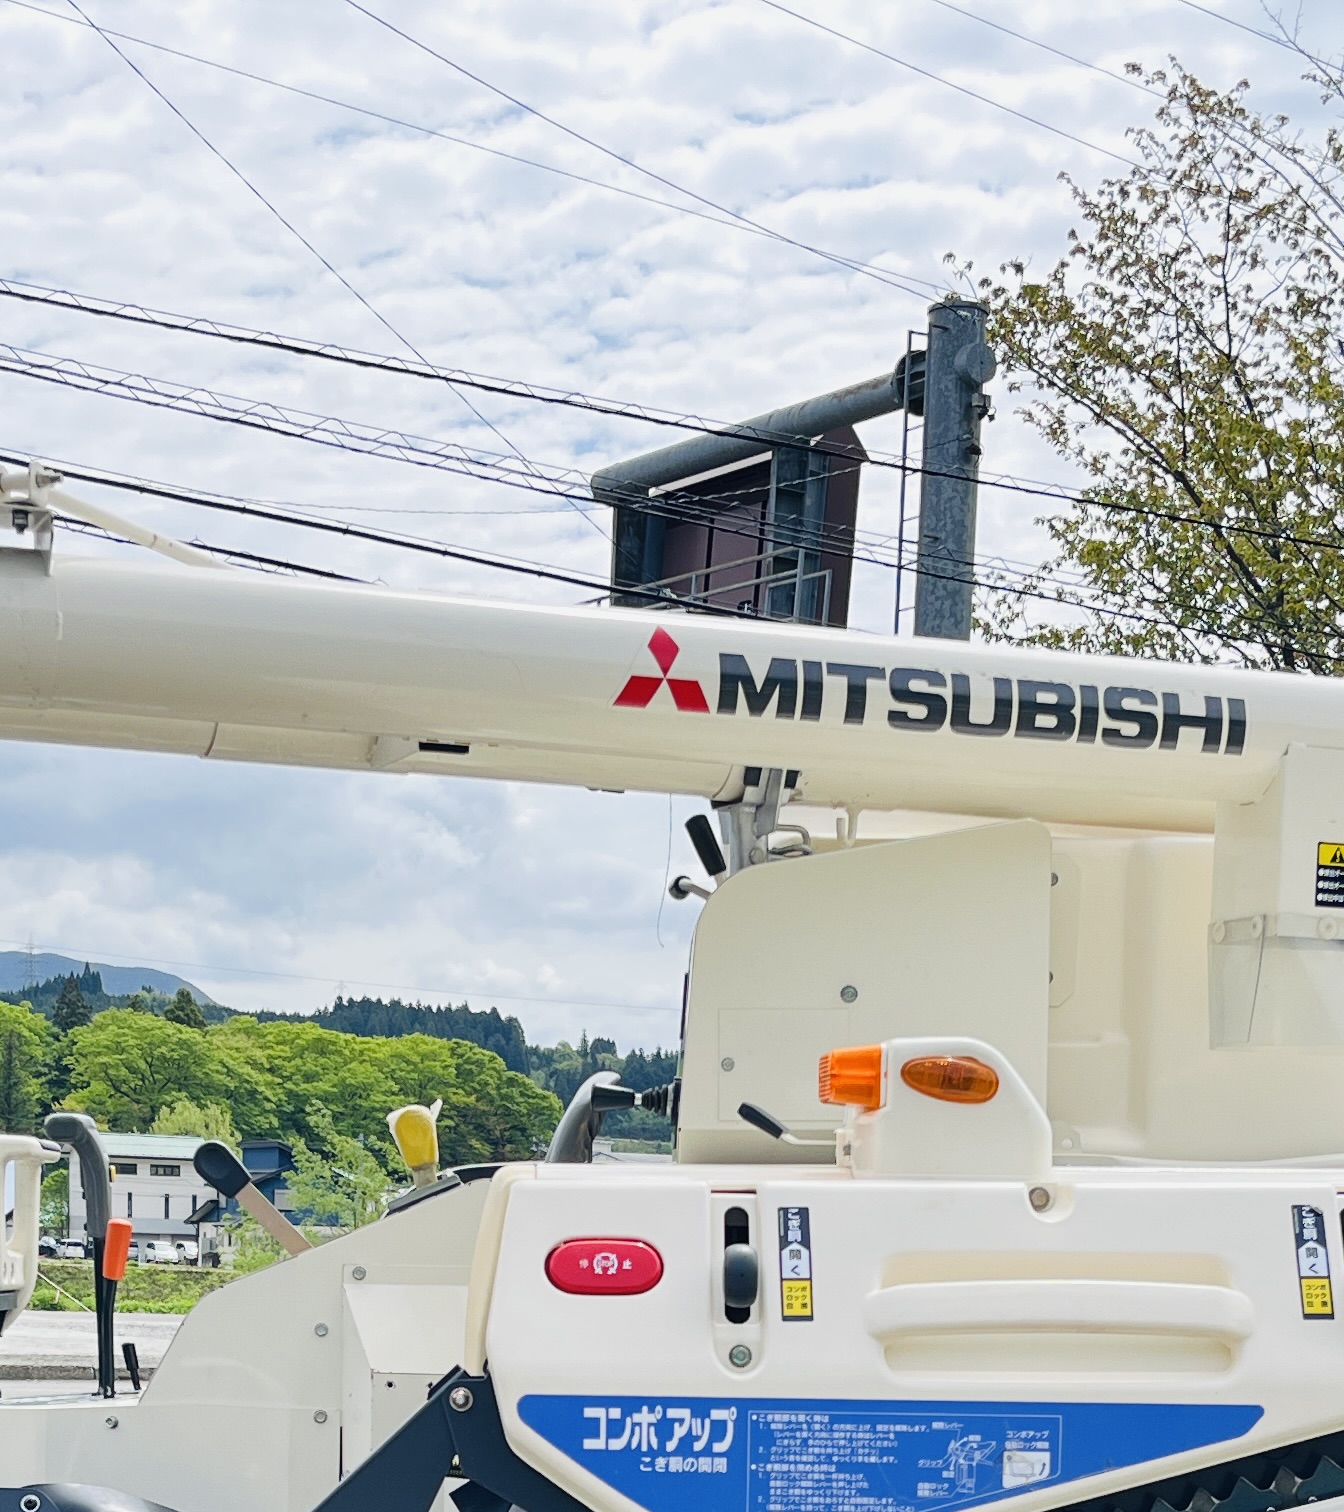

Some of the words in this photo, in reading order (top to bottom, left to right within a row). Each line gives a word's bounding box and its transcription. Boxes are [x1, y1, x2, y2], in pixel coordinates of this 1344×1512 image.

[717, 652, 1248, 757] MITSUBISHI
[583, 1405, 738, 1453] コンポアップ
